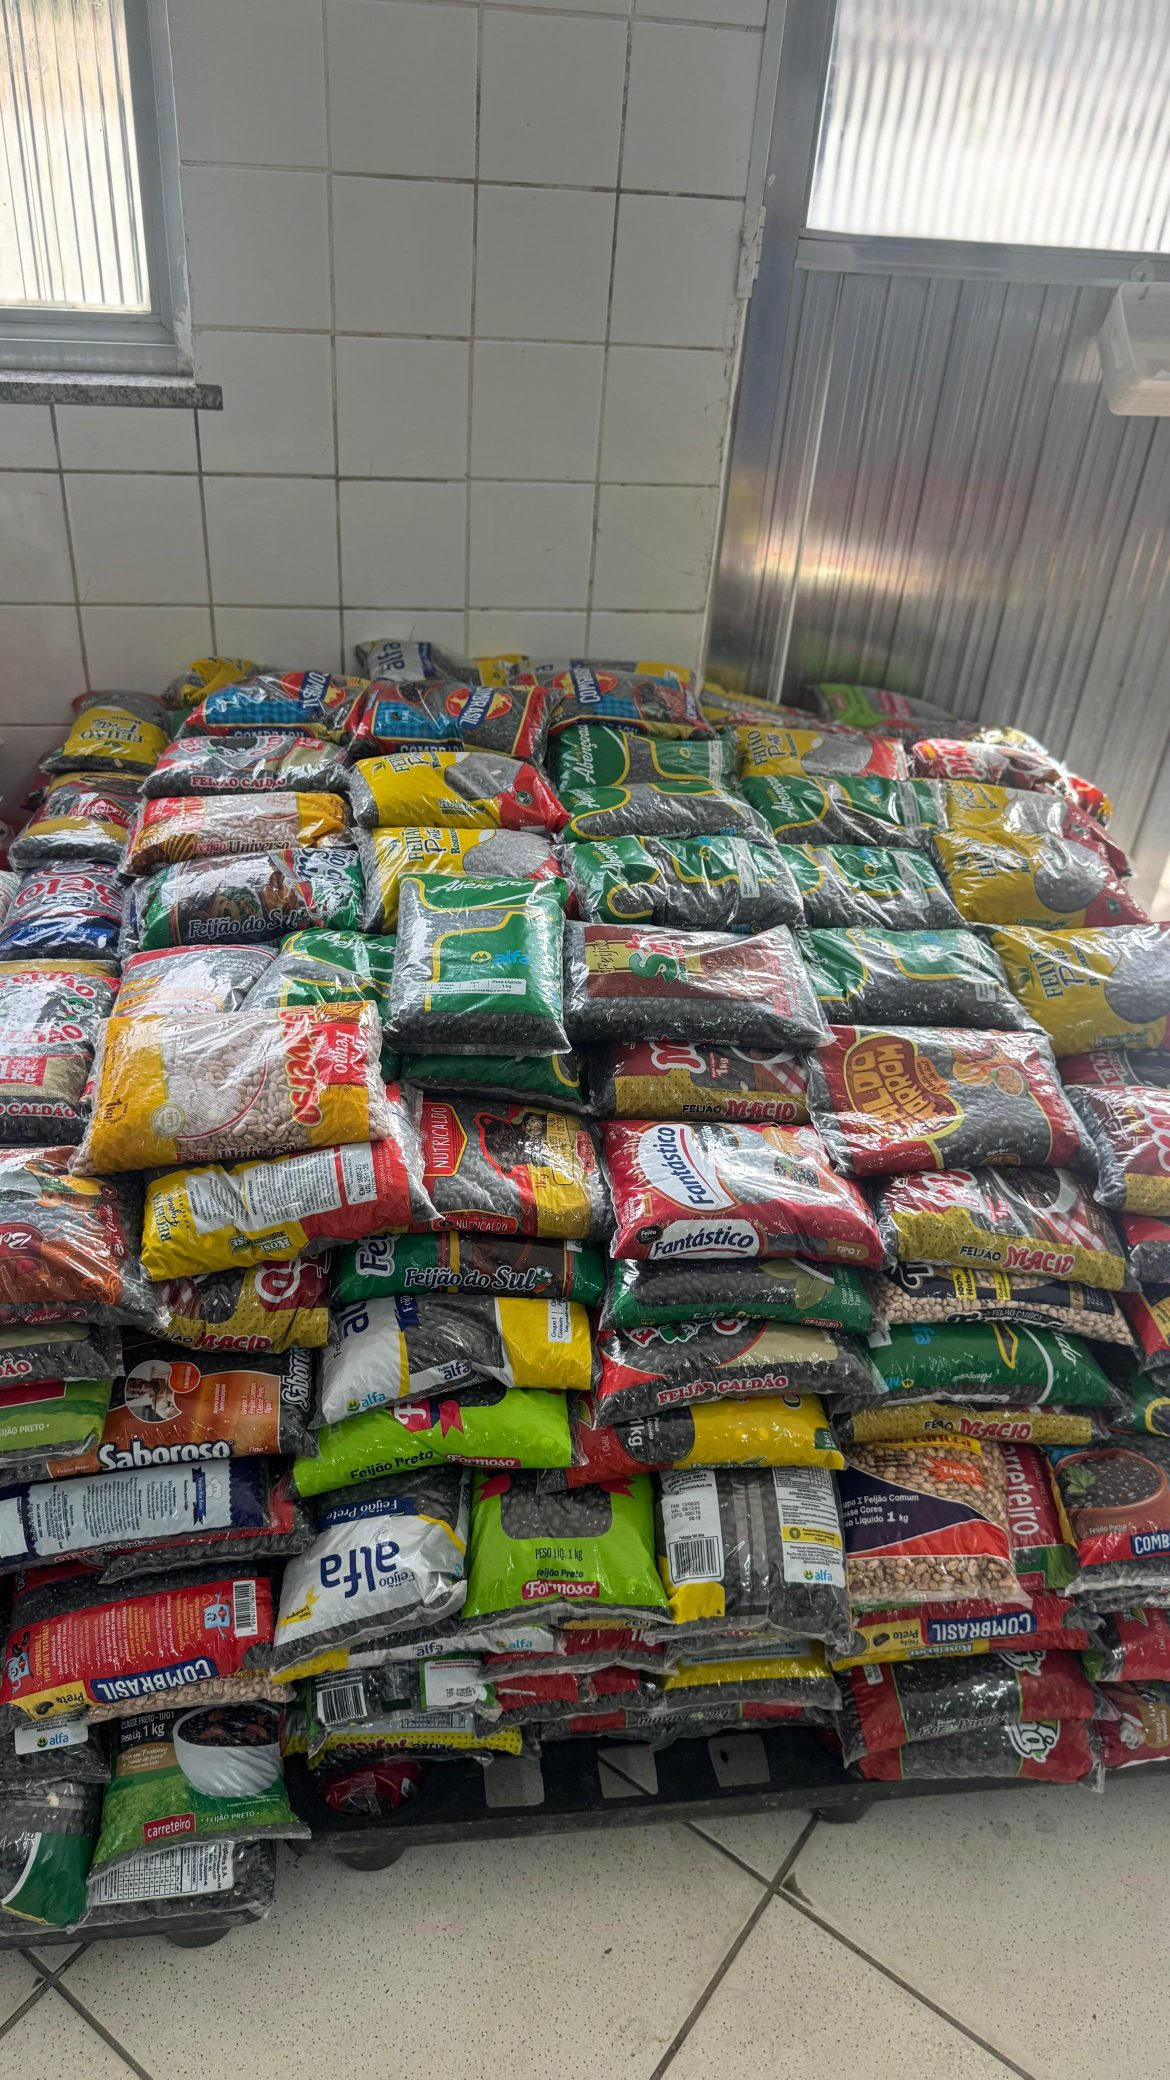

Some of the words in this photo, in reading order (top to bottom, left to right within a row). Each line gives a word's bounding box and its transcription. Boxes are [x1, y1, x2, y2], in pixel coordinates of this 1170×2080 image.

[573, 724, 598, 785] Abençoad
[229, 839, 290, 853] Universo
[188, 917, 238, 939] Feijão
[241, 915, 265, 933] do
[265, 909, 298, 929] Sul
[493, 951, 531, 964] alfa
[1028, 950, 1063, 999] FEIJÃ
[332, 1031, 356, 1073] Feijão
[715, 1057, 729, 1077] 1kg
[852, 1050, 905, 1122] ALDO
[7, 1103, 76, 1119] CALDÃO
[105, 1098, 123, 1120] 1kg
[682, 1104, 722, 1113] FEIJÃO
[432, 1107, 449, 1168] NUTRICALDO
[653, 1126, 714, 1205] Fantástico
[536, 1173, 549, 1189] 1kg
[153, 1191, 173, 1243] RECEITA
[653, 1226, 754, 1258] Fantástico
[836, 1246, 854, 1255] TIPO
[959, 1245, 1001, 1260] FEIJÃO
[1002, 1246, 1075, 1275] MACIO
[404, 1266, 463, 1289] Feijão
[463, 1268, 490, 1288] do
[490, 1265, 536, 1290] Sul
[955, 1274, 964, 1296] 100%
[961, 1268, 974, 1296] Natura
[281, 1347, 311, 1411] Saboro
[444, 1362, 471, 1380] alfa
[717, 1376, 788, 1393] CALDÃO
[241, 1399, 250, 1415] Grupo
[361, 1391, 386, 1408] alfa
[24, 1422, 45, 1436] PRETO
[628, 1416, 645, 1447] 1kg
[959, 1418, 1031, 1440] MACIO
[100, 1436, 231, 1472] Saboroso
[447, 1454, 516, 1467] Formoso
[350, 1463, 393, 1480] Feijão
[396, 1450, 433, 1468] Preto
[942, 1465, 967, 1476] Tipo
[969, 1470, 976, 1478] 1
[356, 1499, 398, 1512] Feijão
[863, 1494, 887, 1504] Feijão
[889, 1494, 919, 1502] Comum
[327, 1507, 353, 1520] Preto
[855, 1515, 884, 1526] Líquido
[887, 1511, 895, 1521] 1
[898, 1515, 909, 1524] kg
[860, 1506, 883, 1514] Cores
[535, 1548, 552, 1560] PESO
[553, 1546, 567, 1560] LÍQ.
[568, 1548, 573, 1560] 1
[574, 1549, 584, 1561] kg
[320, 1540, 400, 1598] alfa
[536, 1568, 559, 1578] Feijão
[561, 1568, 584, 1578] Preto
[815, 1569, 833, 1581] alfa
[379, 1571, 416, 1588] Feijão
[525, 1580, 597, 1598] Formoso
[893, 1630, 918, 1639] Preto
[932, 1613, 1031, 1641] COMBRASIL
[417, 1641, 443, 1657] alfa
[508, 1638, 533, 1649] alfa
[910, 1644, 972, 1657] ROSEIRENSE
[43, 1652, 49, 1661] DE
[44, 1666, 52, 1682] TIPO
[97, 1658, 212, 1700] COMBRASIL
[56, 1691, 85, 1704] Preto
[121, 1718, 138, 1731] CLASSE
[138, 1714, 155, 1727] PRETO
[159, 1712, 172, 1722] TIPO
[50, 1733, 69, 1745] alfa
[121, 1733, 133, 1742] Peso
[143, 1725, 148, 1736] 1
[151, 1722, 165, 1736] kg
[206, 1813, 230, 1824] FEIJÃO
[231, 1810, 255, 1820] PRETO
[147, 1817, 191, 1838] carreteiro
